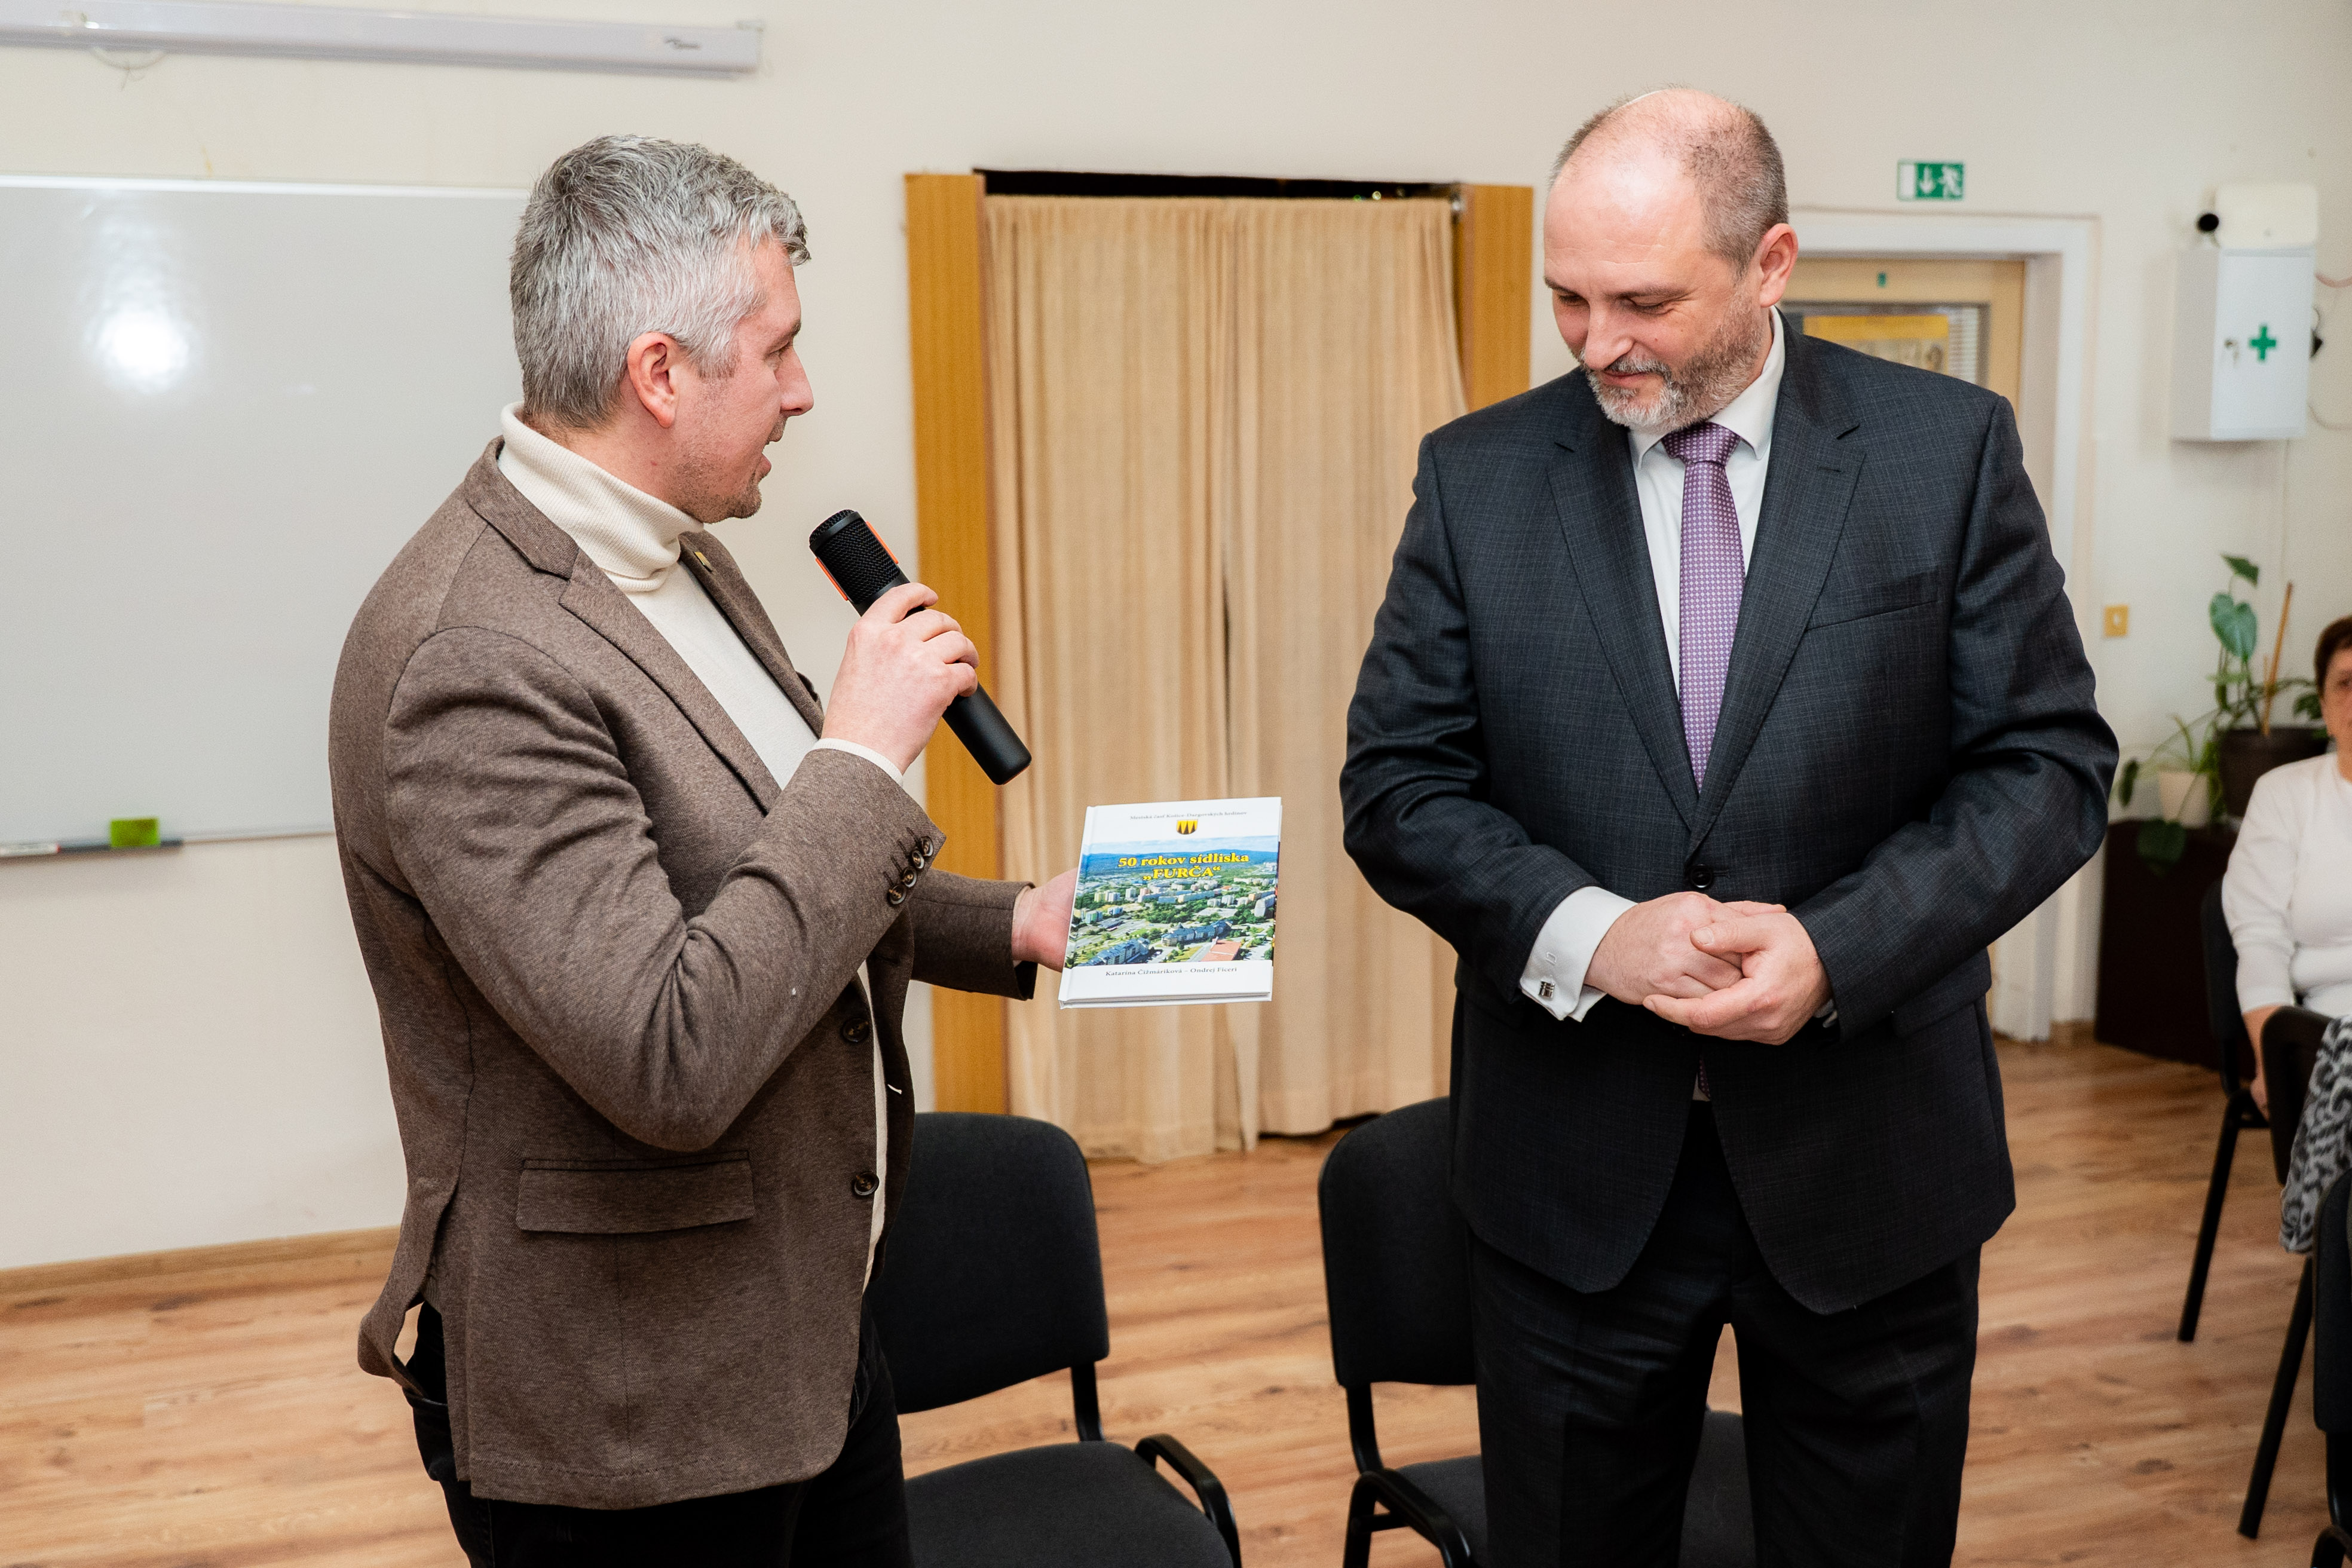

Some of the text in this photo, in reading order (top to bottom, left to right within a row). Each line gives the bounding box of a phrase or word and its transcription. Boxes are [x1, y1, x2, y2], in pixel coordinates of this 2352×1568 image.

[1118, 852, 1250, 867] 50 rokov sídliska
